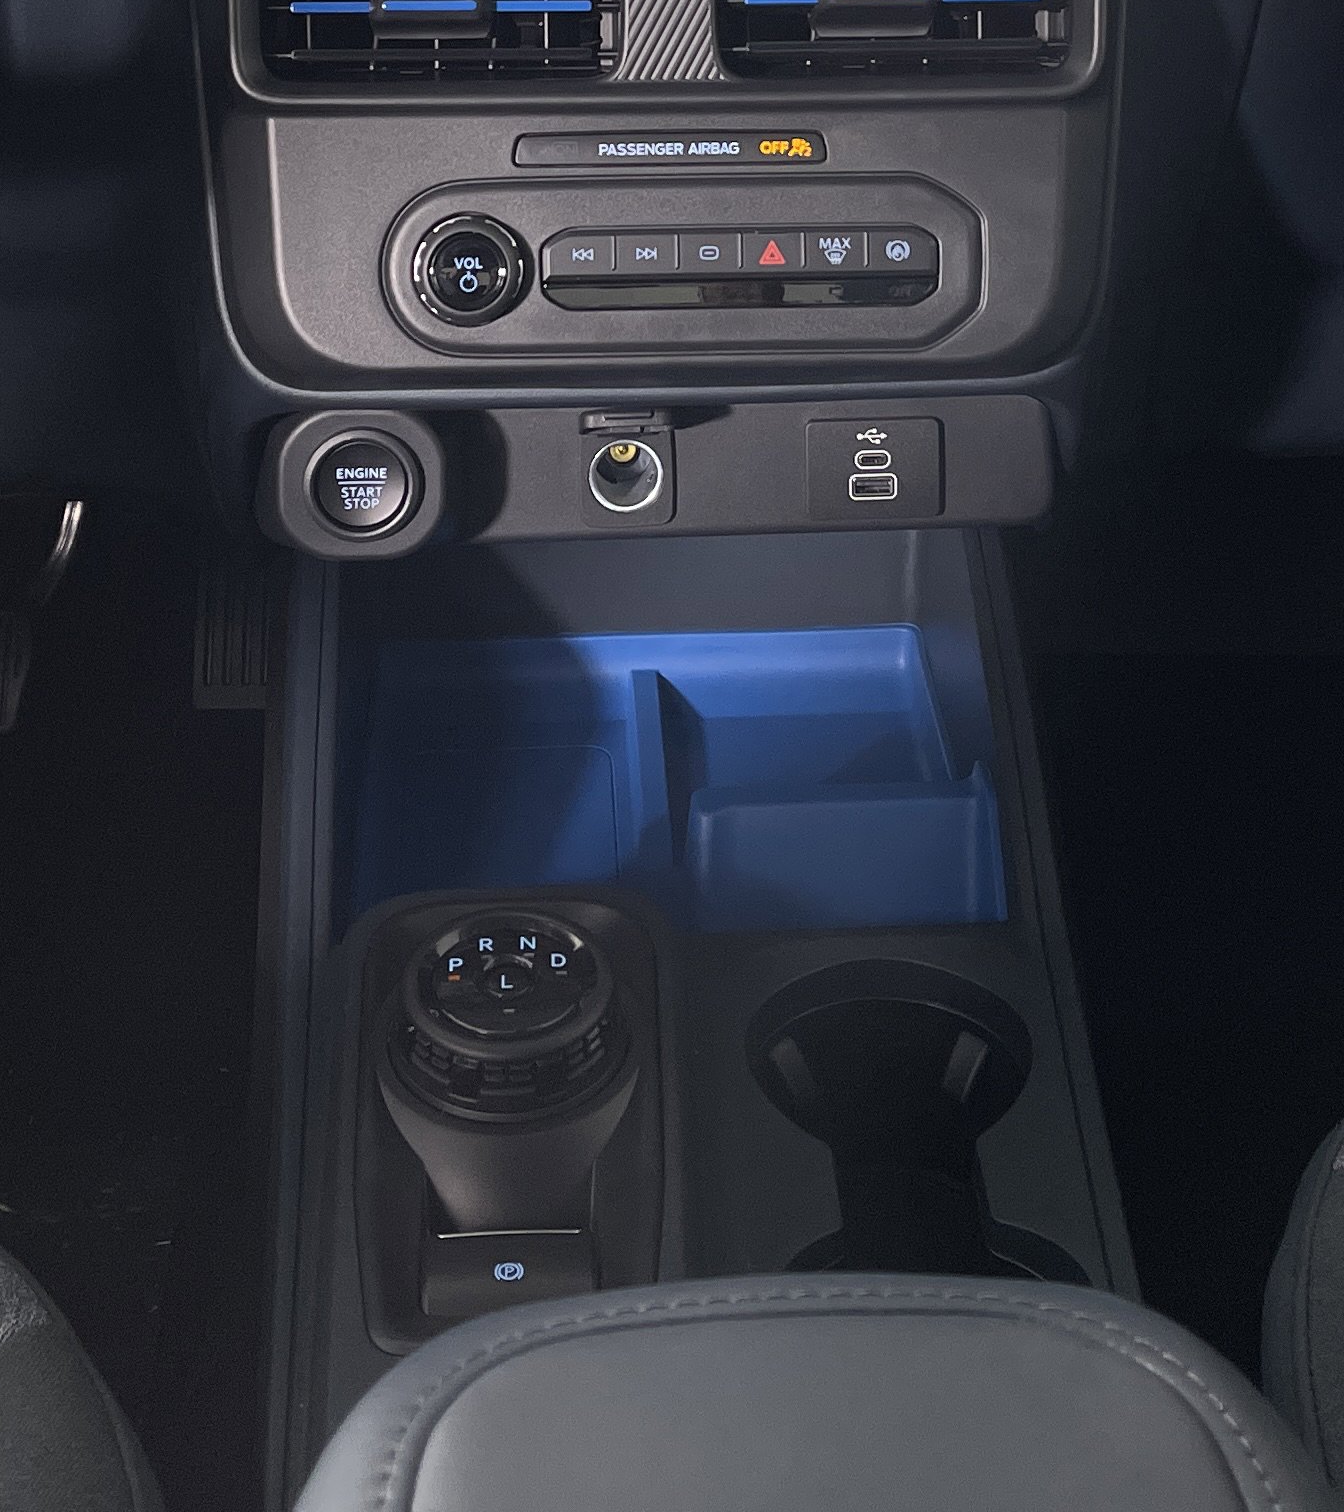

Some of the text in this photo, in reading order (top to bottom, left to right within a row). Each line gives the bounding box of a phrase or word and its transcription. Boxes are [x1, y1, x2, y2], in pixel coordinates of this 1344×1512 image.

[598, 140, 789, 156] PASSENGER AIRBAG OFF
[819, 237, 851, 249] MAX
[454, 257, 483, 270] VOL
[336, 467, 388, 479] ENGINE
[341, 486, 383, 498] START
[344, 498, 380, 511] STOP
[449, 936, 566, 972] P R N D
[501, 975, 513, 989] L
